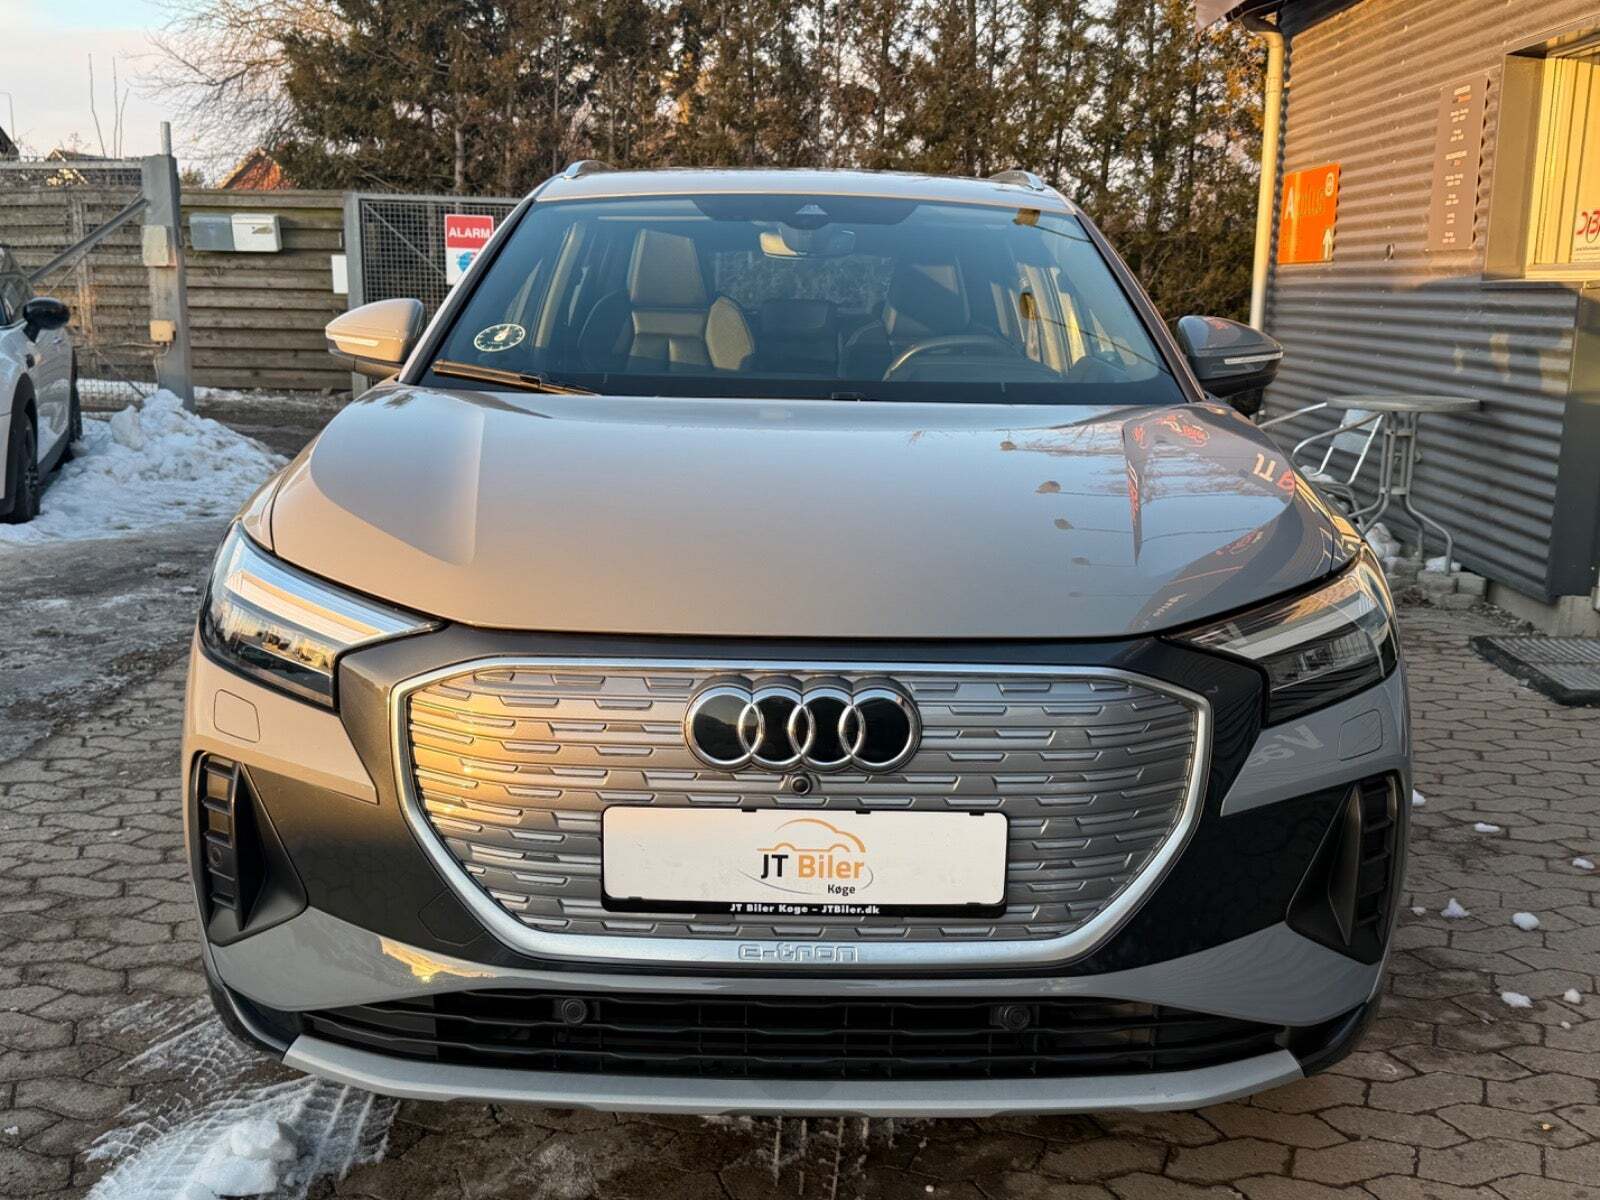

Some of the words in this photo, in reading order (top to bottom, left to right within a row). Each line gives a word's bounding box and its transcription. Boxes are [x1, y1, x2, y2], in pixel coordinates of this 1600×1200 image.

[449, 227, 490, 239] ALARM
[760, 854, 788, 879] JT
[798, 854, 864, 879] Biler
[827, 884, 856, 896] Køge
[730, 904, 742, 912] JT
[746, 904, 775, 913] Biler
[821, 905, 880, 915] JTBiler.dk
[738, 942, 858, 963] e-tron
